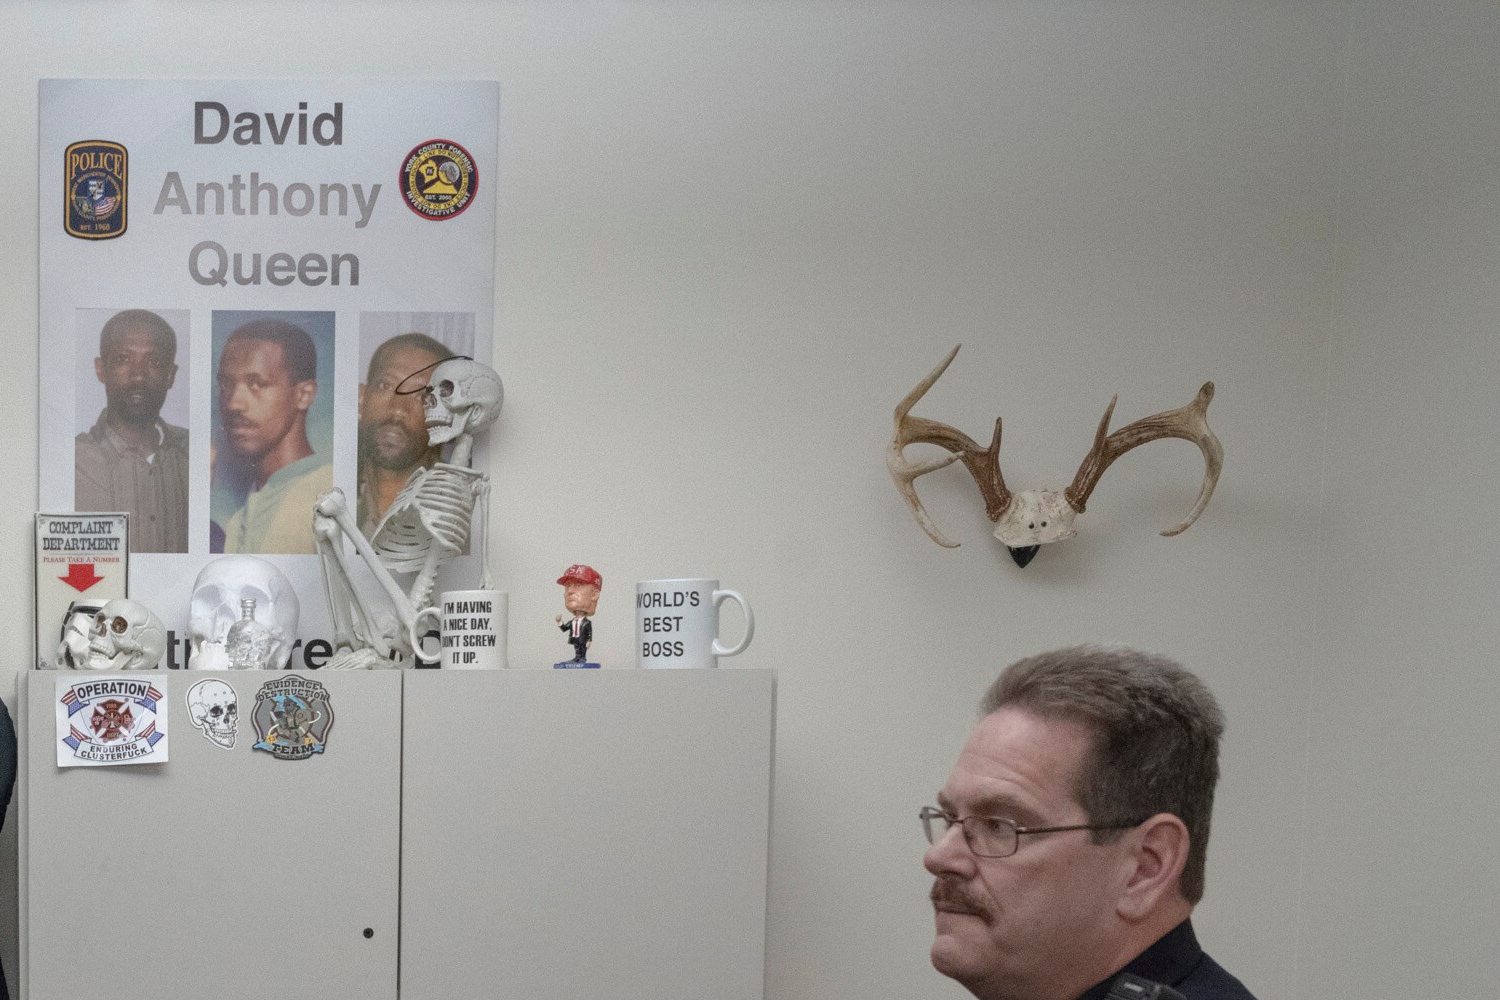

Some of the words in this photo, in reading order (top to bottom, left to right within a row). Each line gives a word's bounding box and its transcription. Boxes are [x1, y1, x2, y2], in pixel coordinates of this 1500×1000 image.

[194, 101, 343, 146] David
[404, 154, 418, 173] YORK
[418, 143, 446, 155] COUNTY
[448, 145, 474, 173] FORENSIC
[71, 152, 122, 180] POLICE
[153, 172, 382, 228] Anthony
[406, 190, 456, 216] INVESTIGATIVE
[457, 192, 471, 208] UNIT
[188, 240, 360, 287] Queen
[49, 521, 113, 534] COMPLAINT
[42, 537, 120, 551] DEPARTMENT
[636, 591, 700, 608] WORLD'S
[444, 602, 454, 614] I'M
[456, 601, 492, 613] HAVING
[443, 619, 447, 631] A
[449, 618, 468, 631] NICE
[470, 618, 492, 631] DAY,
[643, 617, 683, 632] BEST
[441, 635, 460, 648] DON'T
[463, 634, 497, 647] SCREW
[642, 641, 684, 658] BOSS
[453, 652, 460, 664] IT
[463, 652, 478, 664] UP.
[77, 682, 147, 699] OPERATION
[266, 680, 320, 691] EVIDENCE
[258, 688, 329, 701] DESTRUCTION
[80, 747, 148, 760] CLUSTERFUCK
[90, 743, 138, 754] ENDURING
[273, 743, 315, 755] TEAM
